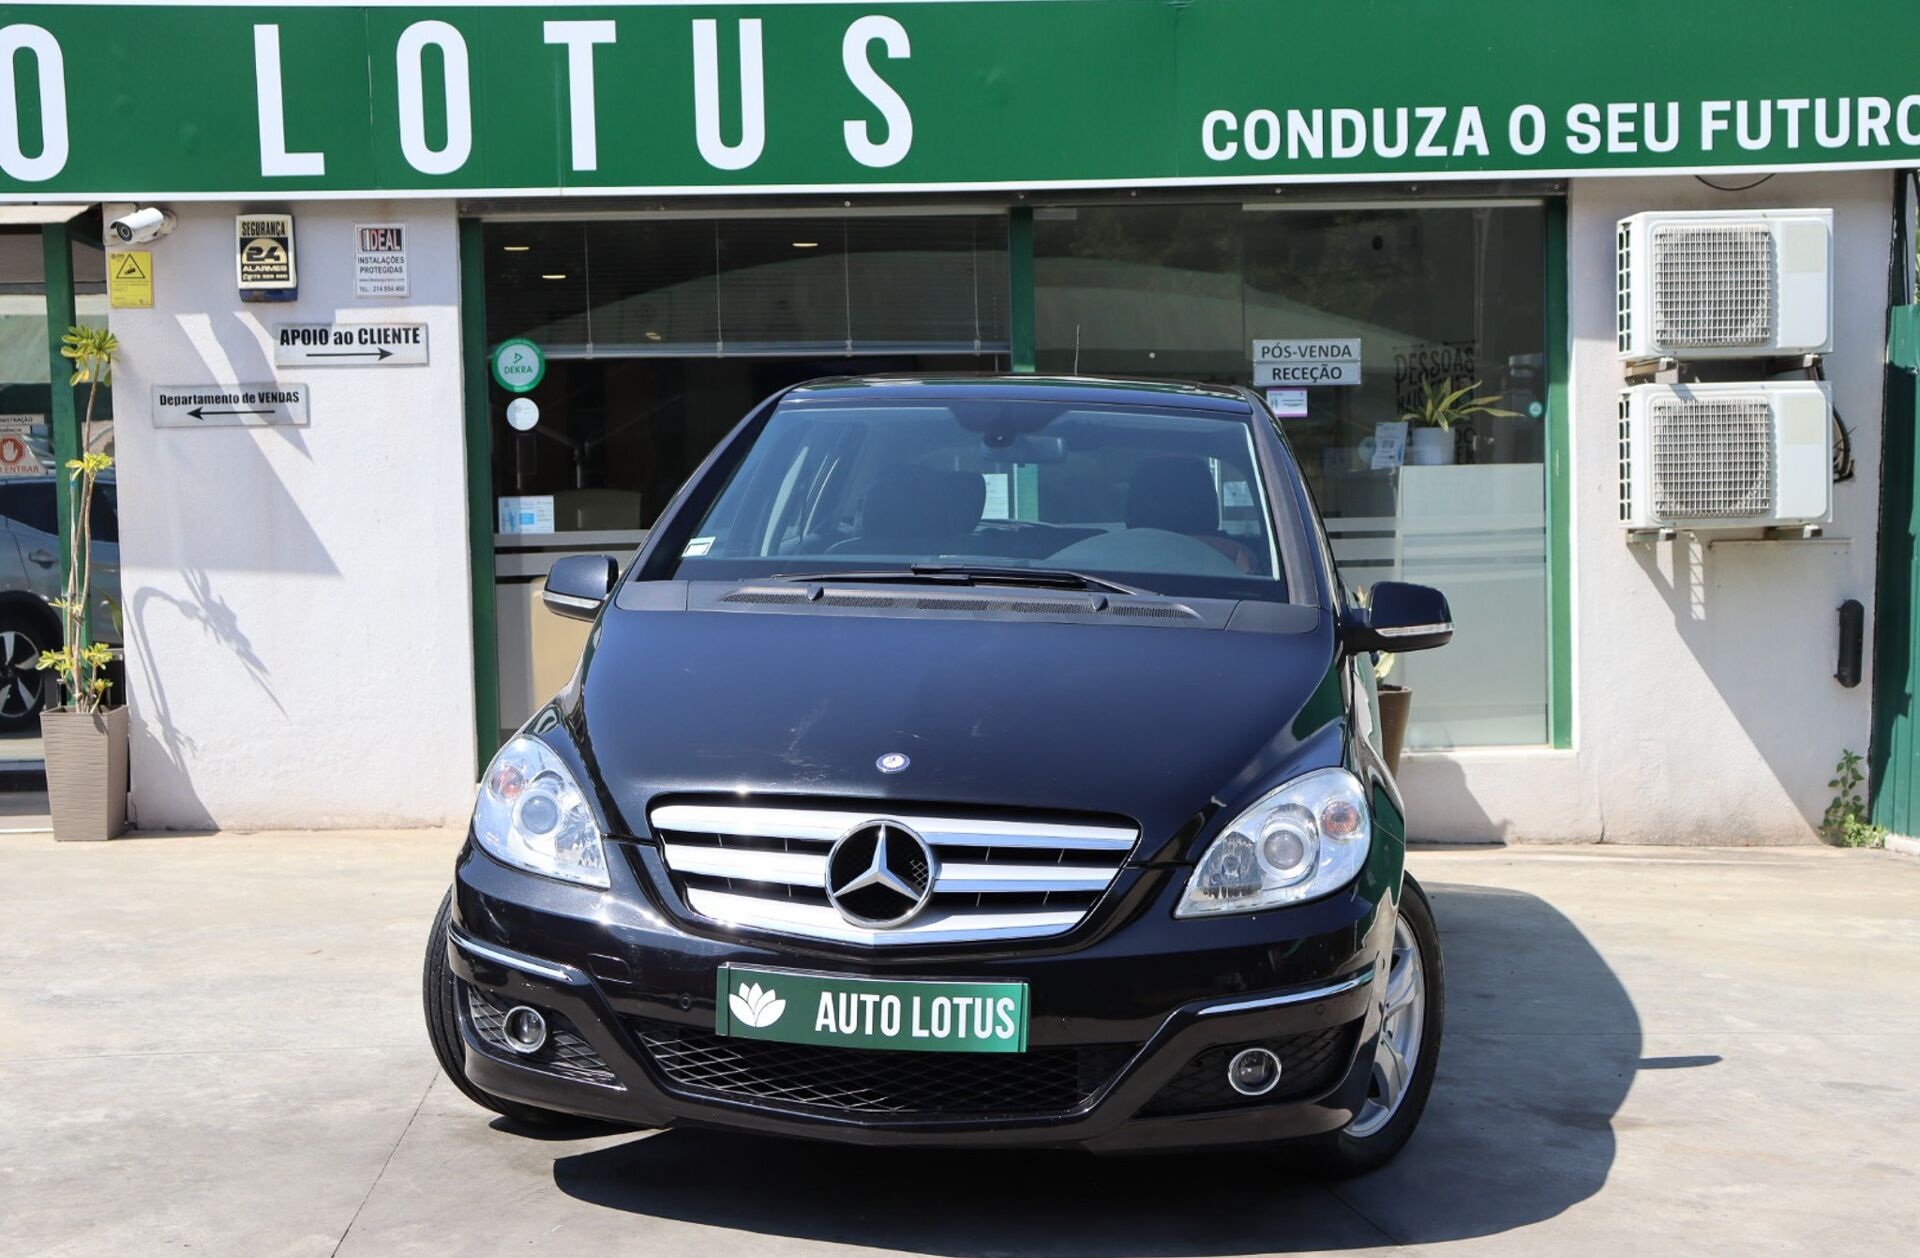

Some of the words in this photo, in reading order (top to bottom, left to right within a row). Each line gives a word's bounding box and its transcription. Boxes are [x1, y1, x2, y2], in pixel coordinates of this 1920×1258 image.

[0, 23, 69, 182] O
[253, 14, 914, 178] LOTUS
[1201, 106, 1490, 161] CONDUZA
[1508, 104, 1548, 156] O
[1565, 101, 1680, 155] SEU
[241, 221, 287, 237] SEGURANÇA
[246, 246, 281, 261] 24
[357, 256, 405, 265] INSTALAÇÕES
[359, 265, 403, 274] PROTEGIDAS
[280, 329, 329, 346] APOIO
[333, 333, 352, 345] ao
[358, 327, 421, 345] CLIENTE
[1261, 342, 1352, 359] PÓS-VENDA
[504, 365, 533, 375] DEKRA
[1272, 363, 1342, 383] RECEÇÃO
[159, 394, 239, 406] Departamento
[242, 391, 256, 404] de
[257, 391, 300, 404] VENDAS
[815, 991, 901, 1036] AUTO
[912, 996, 1015, 1039] LOTUS
